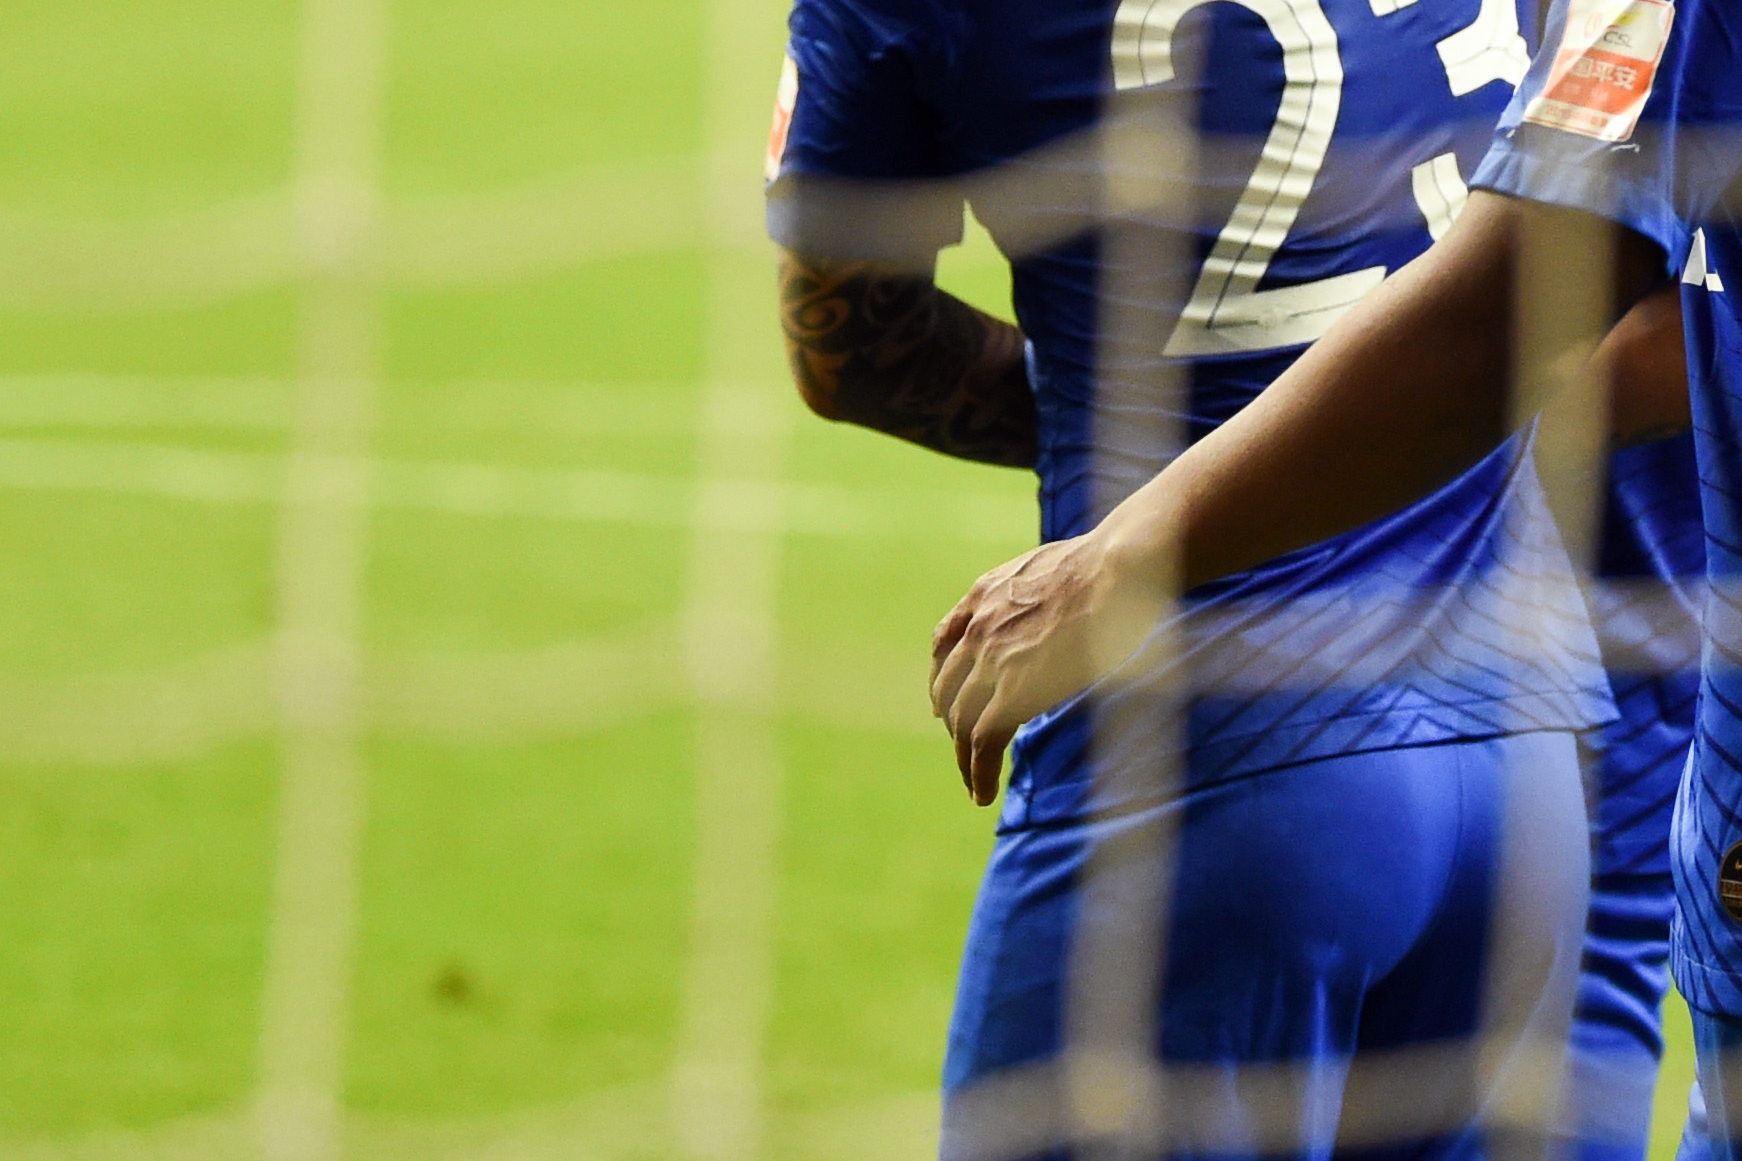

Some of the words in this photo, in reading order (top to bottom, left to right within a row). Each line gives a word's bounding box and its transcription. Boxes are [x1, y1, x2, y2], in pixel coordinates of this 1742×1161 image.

[1603, 29, 1633, 48] CSL
[1563, 55, 1638, 90] 国平安
